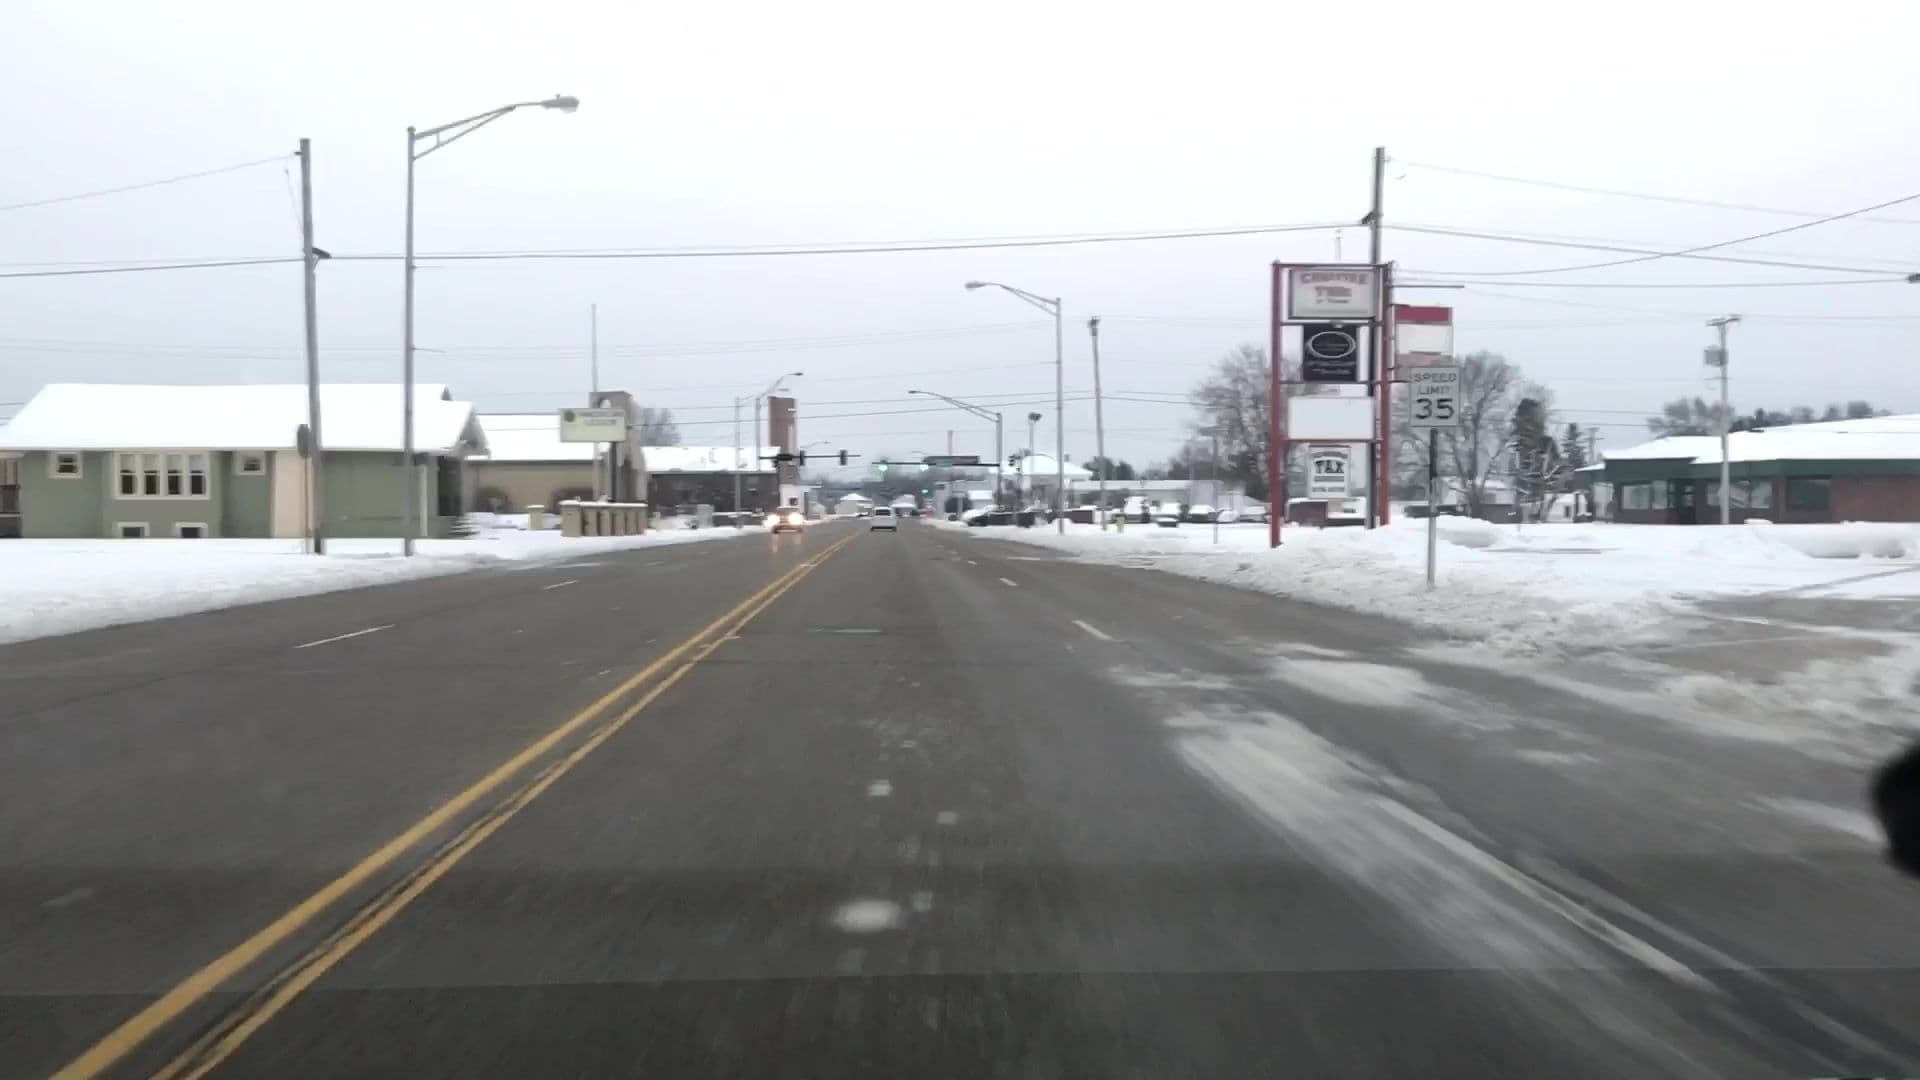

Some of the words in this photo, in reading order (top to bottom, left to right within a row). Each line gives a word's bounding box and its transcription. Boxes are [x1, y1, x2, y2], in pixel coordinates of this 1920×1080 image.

[1414, 373, 1457, 382] SPEED
[1416, 386, 1451, 395] LIMIT
[1415, 398, 1455, 419] 35
[1315, 460, 1345, 474] TAX
